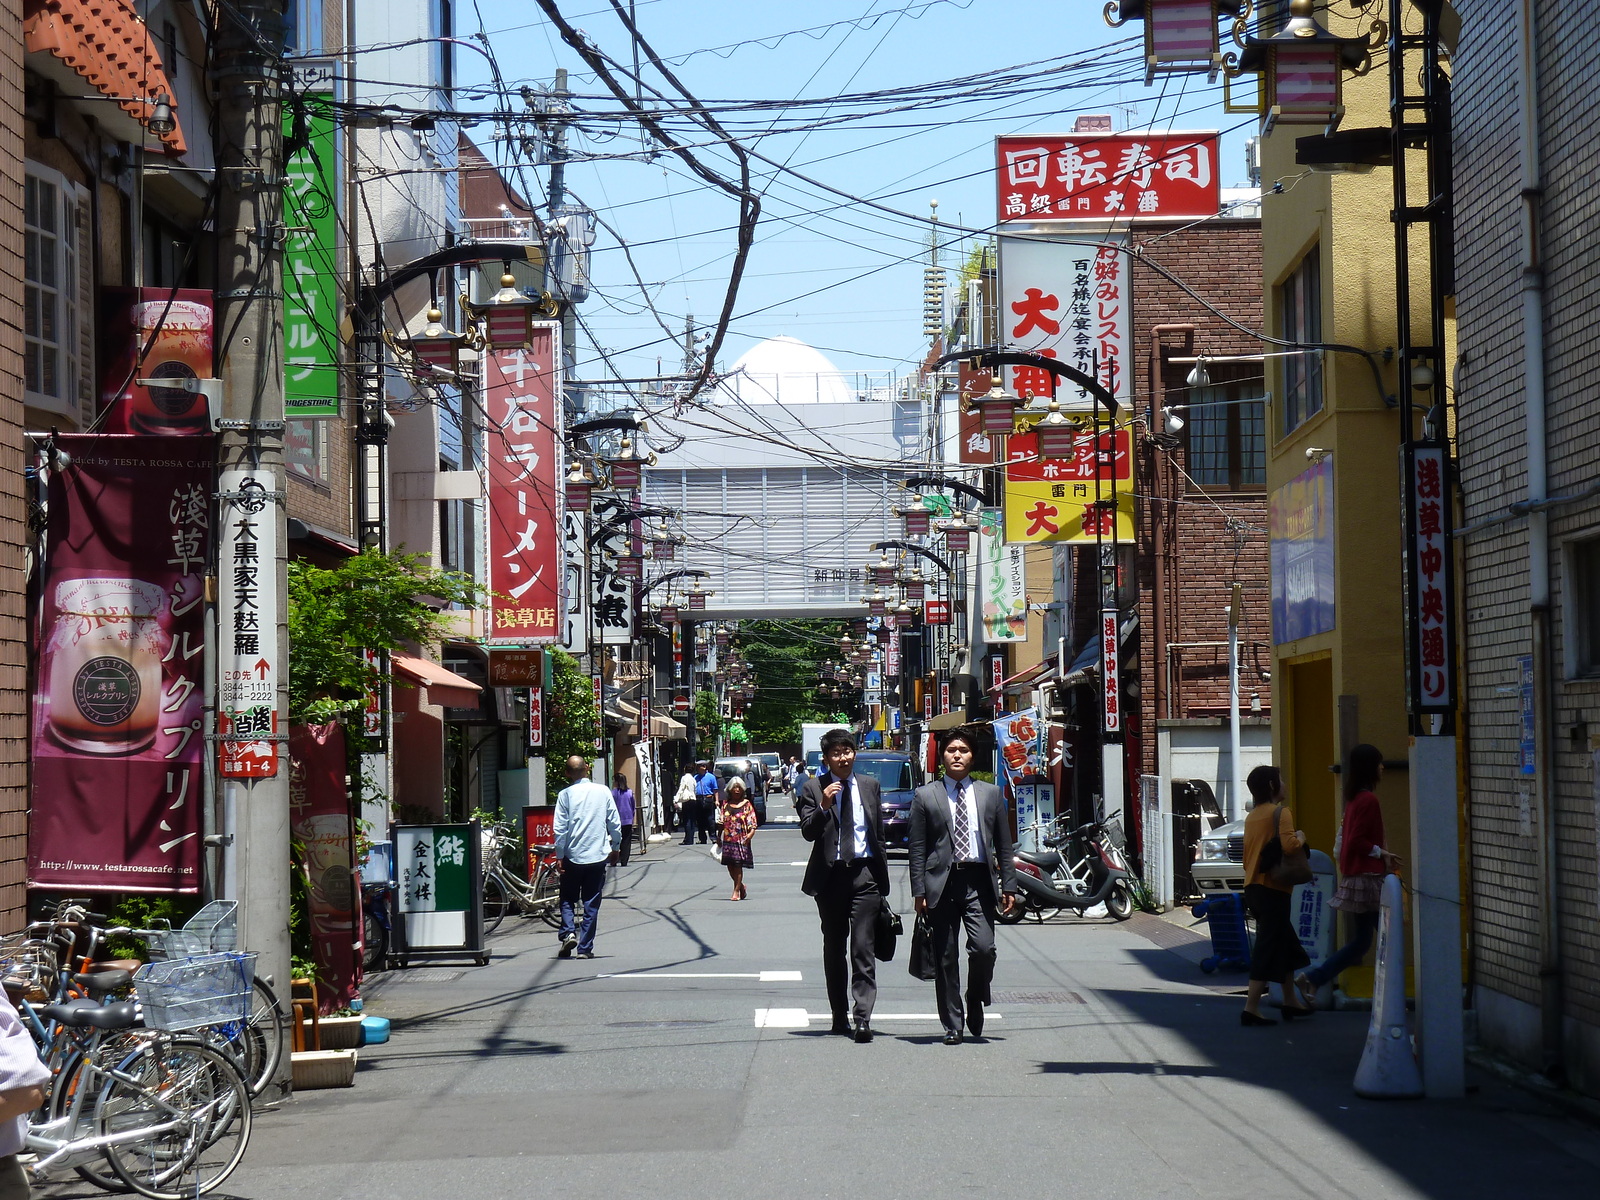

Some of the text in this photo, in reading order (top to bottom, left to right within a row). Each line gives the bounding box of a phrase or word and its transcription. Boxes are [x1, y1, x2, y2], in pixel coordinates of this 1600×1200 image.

[1005, 142, 1211, 192] 回転寿司
[1005, 193, 1053, 215] 高級
[1104, 190, 1159, 213] 大番
[1071, 258, 1092, 399] 百名様迄宴会承りす
[1011, 288, 1062, 399] 大番
[113, 458, 146, 466] TESTA
[149, 460, 184, 468] ROSSA
[500, 349, 544, 600] 千石ラーメン
[1043, 464, 1094, 478] ホール
[1051, 484, 1087, 497] 雷門
[1025, 501, 1114, 536] 大番
[1417, 458, 1446, 698] 浅草中央通り
[496, 607, 555, 628] 浅草店
[224, 670, 252, 681] この先
[1105, 617, 1118, 729] 浅草中央通り
[223, 683, 271, 691] 3844-1111
[223, 693, 272, 701] 3844-2222
[245, 761, 270, 771] 1-4
[436, 835, 465, 866] 鮨
[40, 860, 193, 875] http://www.testarossacafe.net
[413, 840, 432, 901] 金太楼
